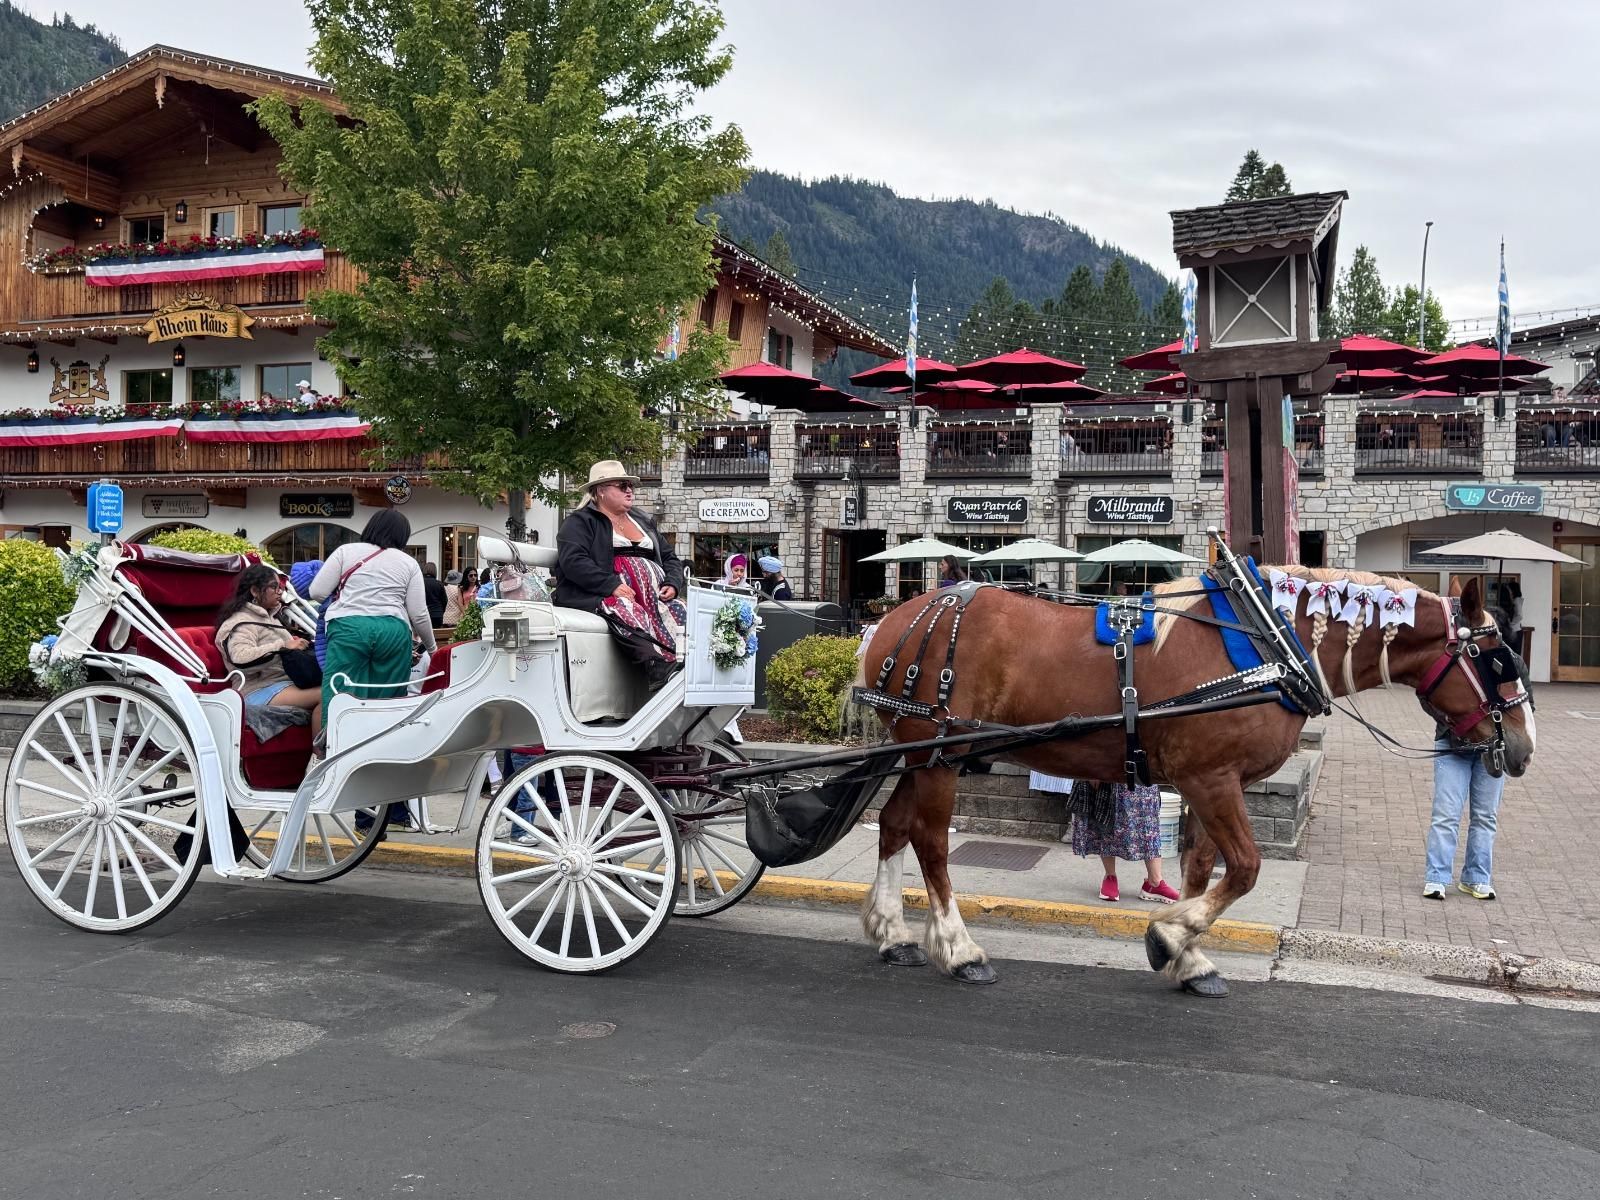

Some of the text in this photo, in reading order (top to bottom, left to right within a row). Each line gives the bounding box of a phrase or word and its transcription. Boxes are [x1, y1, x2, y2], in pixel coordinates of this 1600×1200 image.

[156, 312, 228, 337] Rhein Haus
[1094, 497, 1166, 513] Milbrandt
[1487, 488, 1536, 508] Coffee
[288, 503, 331, 517] BOOK
[702, 508, 766, 517] ICE CREAM CO.
[952, 499, 1022, 514] Ryan Patrick
[965, 511, 1010, 522] Wine Tasting
[1106, 511, 1154, 523] Wine Tasting
